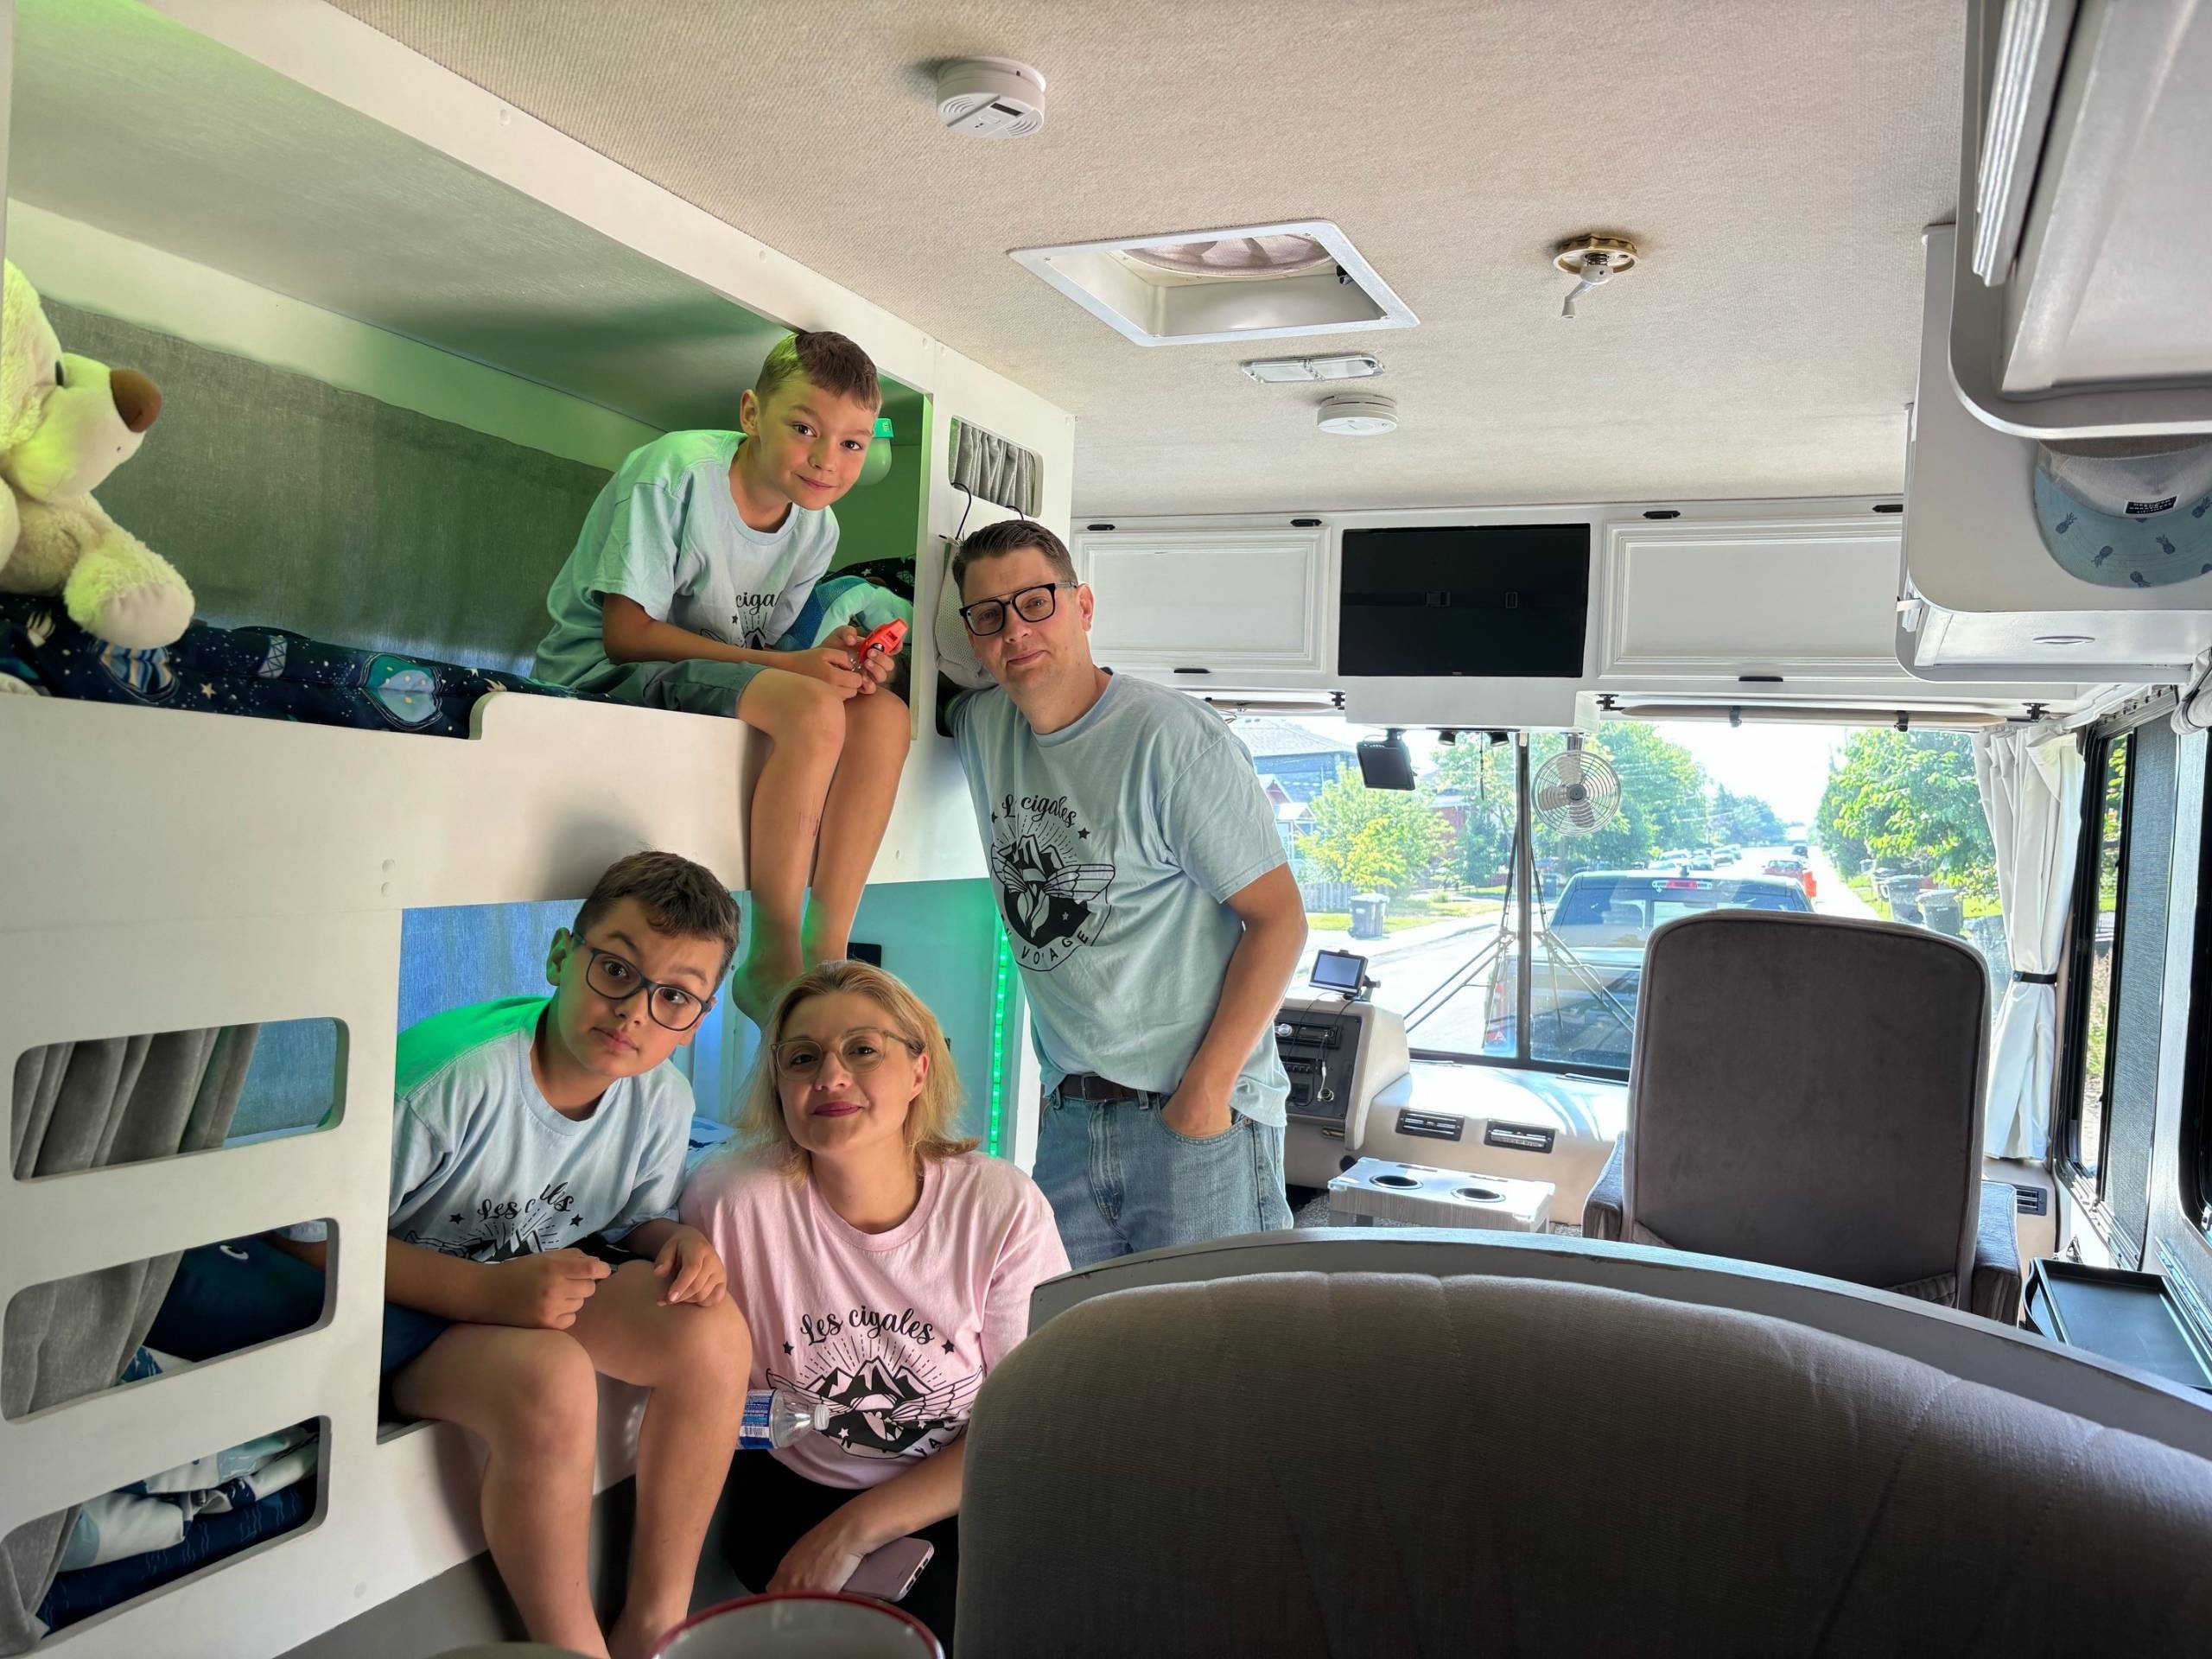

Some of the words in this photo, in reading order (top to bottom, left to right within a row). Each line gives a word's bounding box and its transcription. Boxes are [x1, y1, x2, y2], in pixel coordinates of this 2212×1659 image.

[735, 591, 780, 615] ciga
[1020, 795, 1078, 829] cigales
[1020, 931, 1089, 964] VOAGE
[478, 1198, 521, 1222] Les
[800, 1313, 843, 1345] Les
[849, 1305, 935, 1344] cigales
